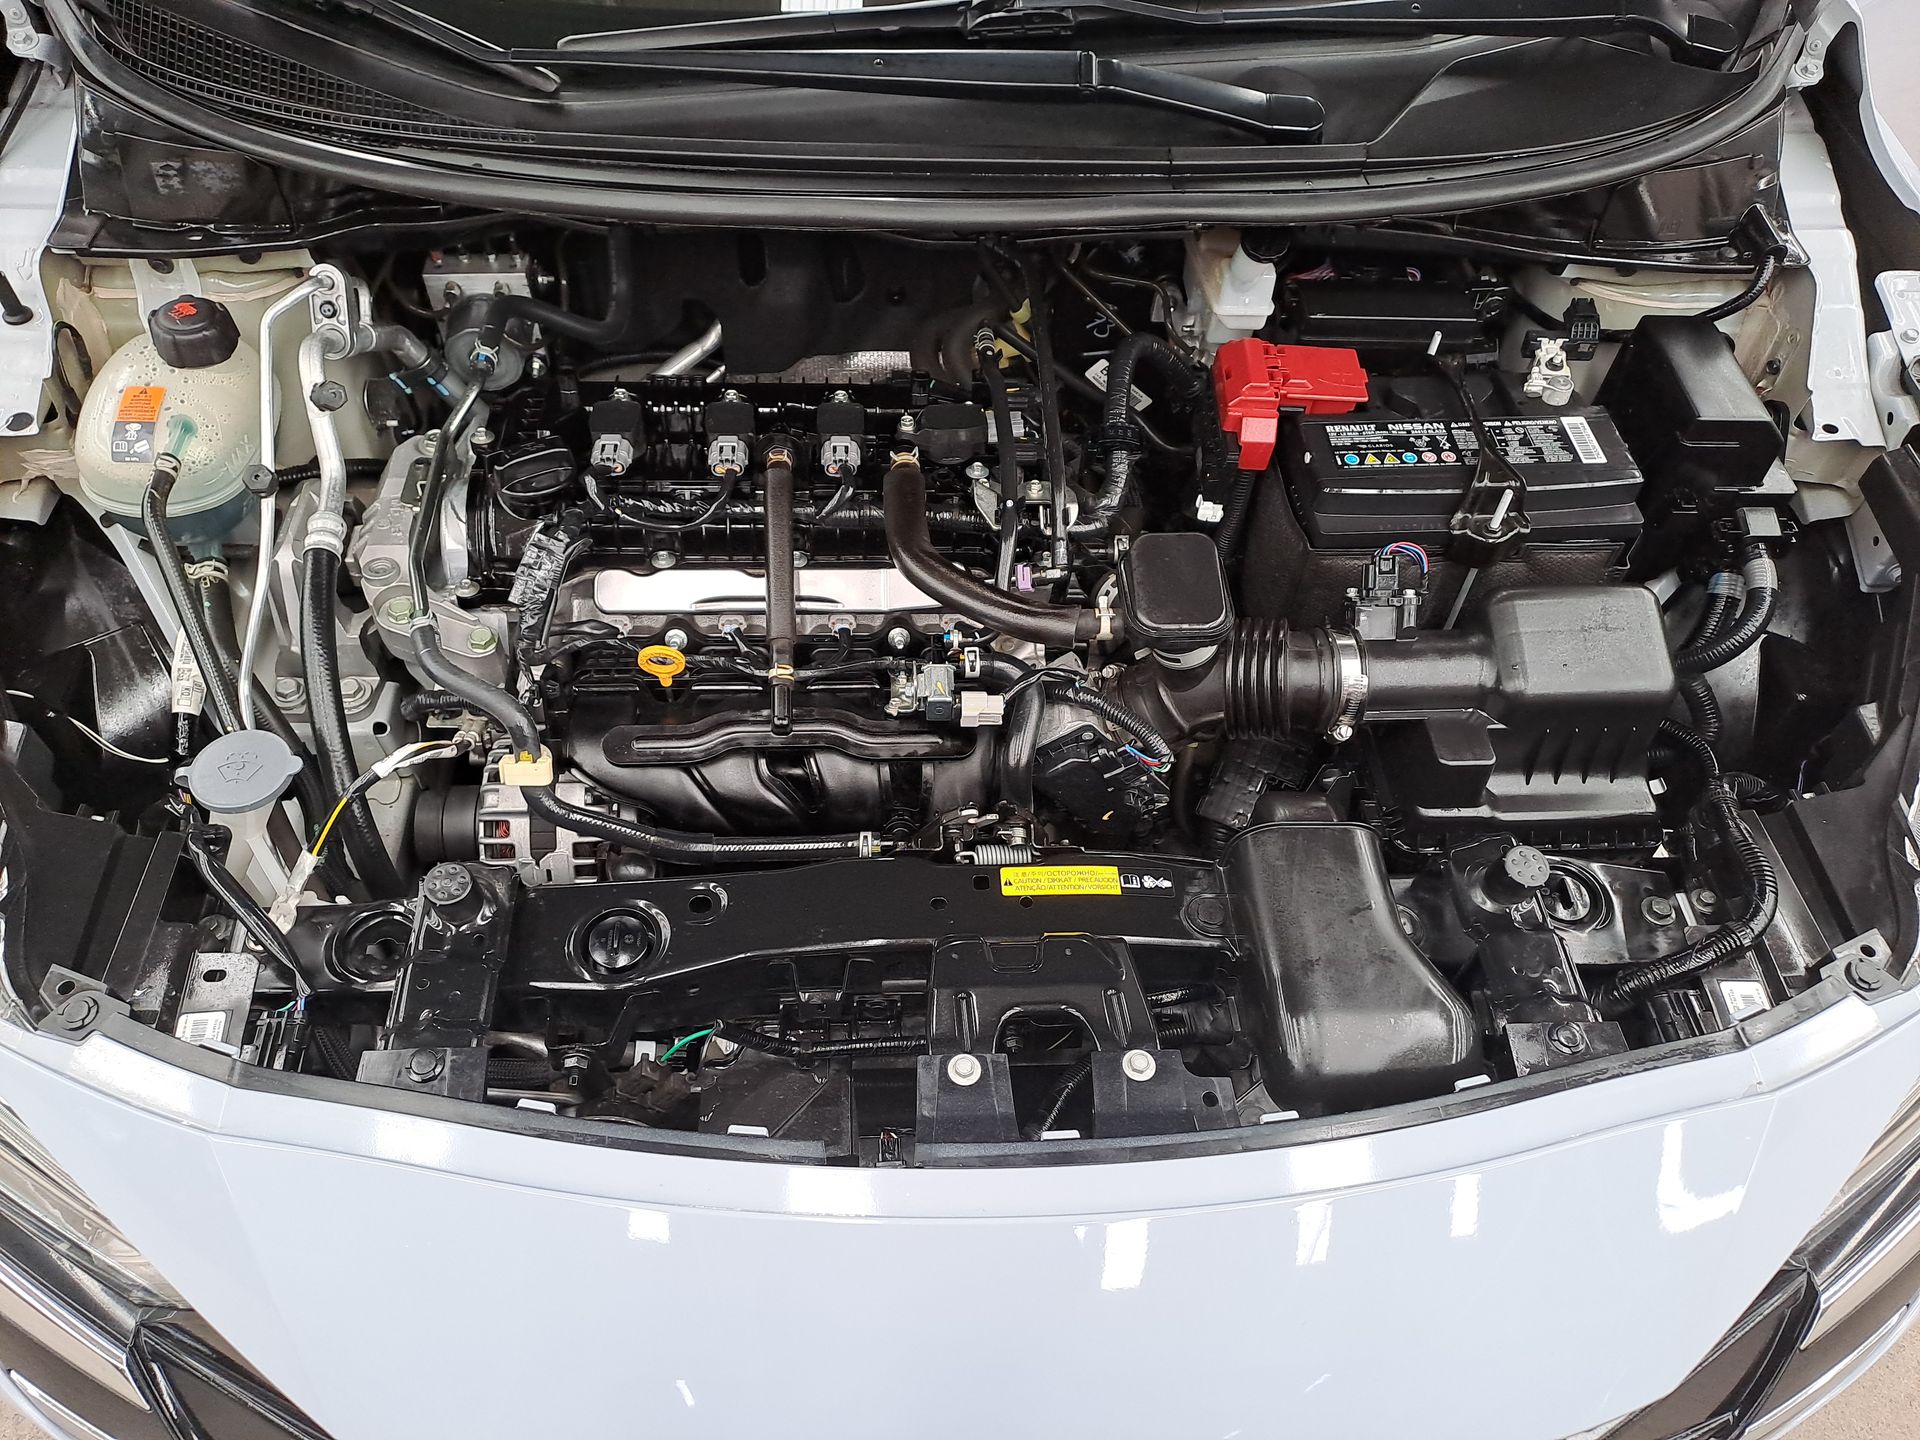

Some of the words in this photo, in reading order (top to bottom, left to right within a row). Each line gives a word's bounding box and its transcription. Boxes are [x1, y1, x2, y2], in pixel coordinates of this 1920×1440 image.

[1325, 424, 1376, 433] RENAULT
[1387, 422, 1445, 431] NISSAN
[1047, 876, 1072, 884] DIKKAT
